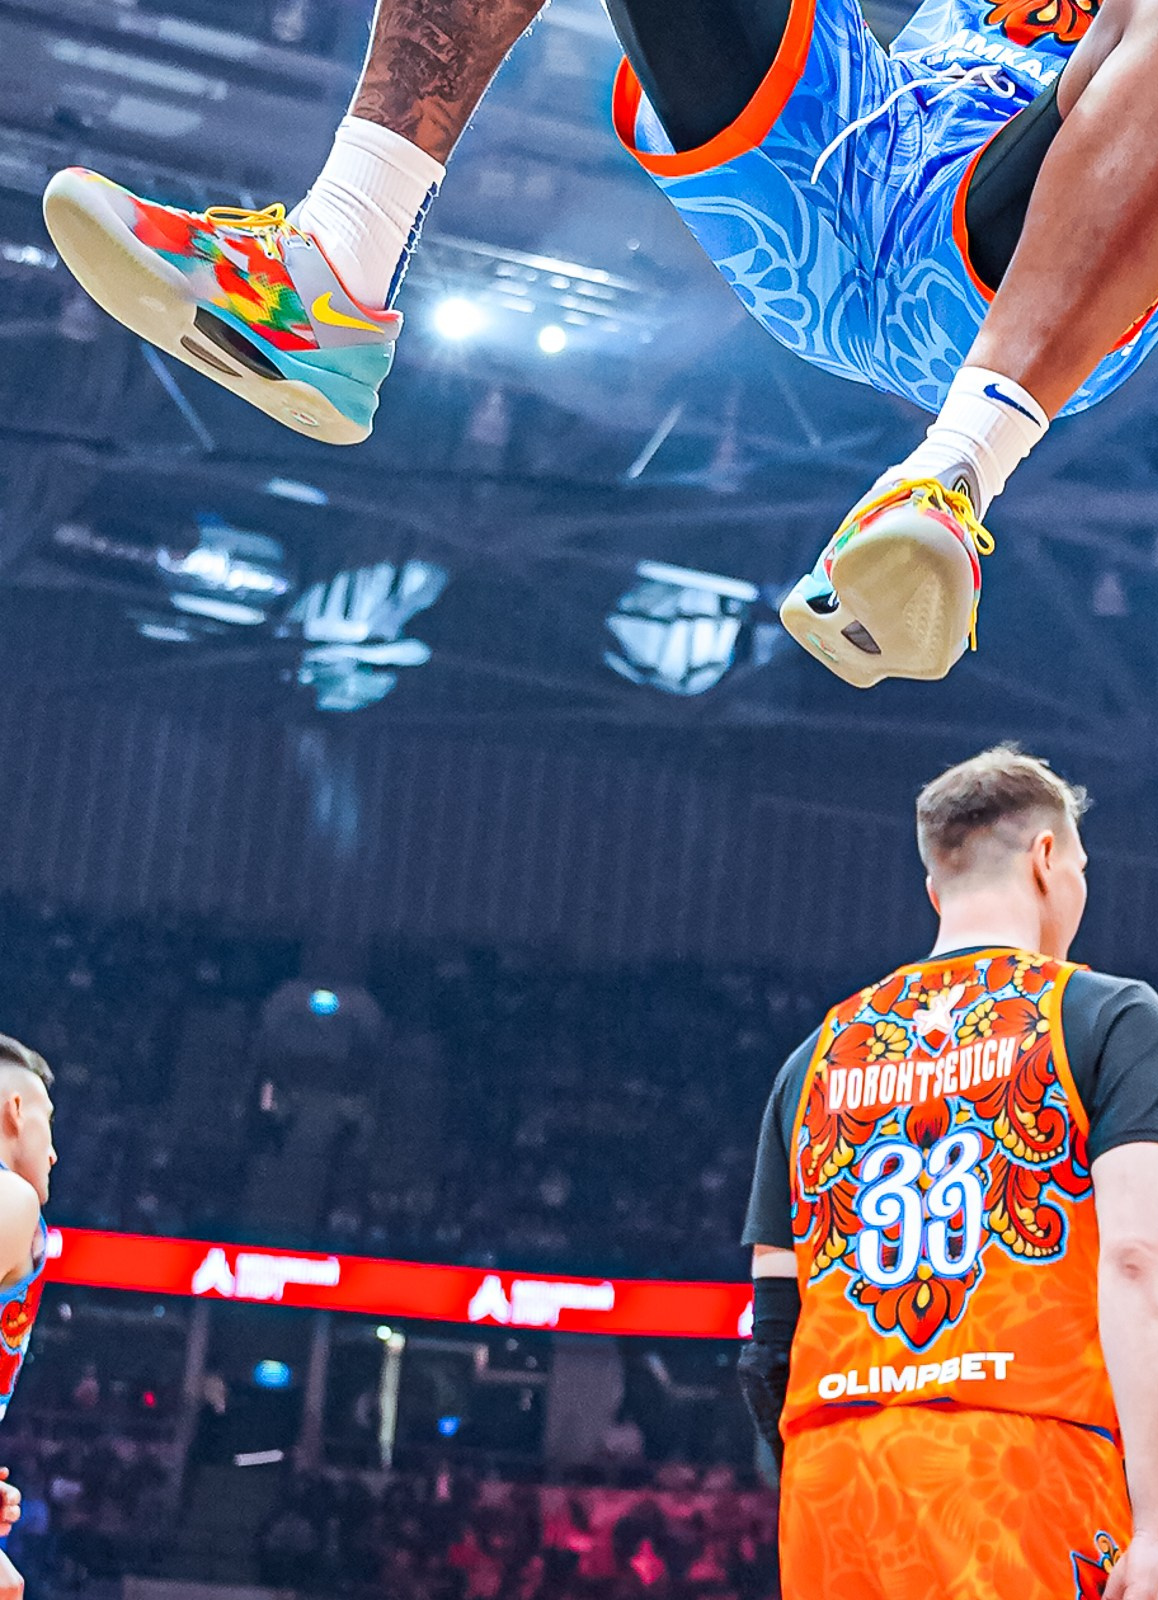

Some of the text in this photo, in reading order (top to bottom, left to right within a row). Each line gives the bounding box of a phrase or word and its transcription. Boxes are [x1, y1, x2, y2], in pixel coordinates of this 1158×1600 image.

[828, 1036, 1017, 1110] VORONTSEVICH
[858, 1131, 983, 1286] 33
[817, 1351, 1015, 1400] OLIMPBET
